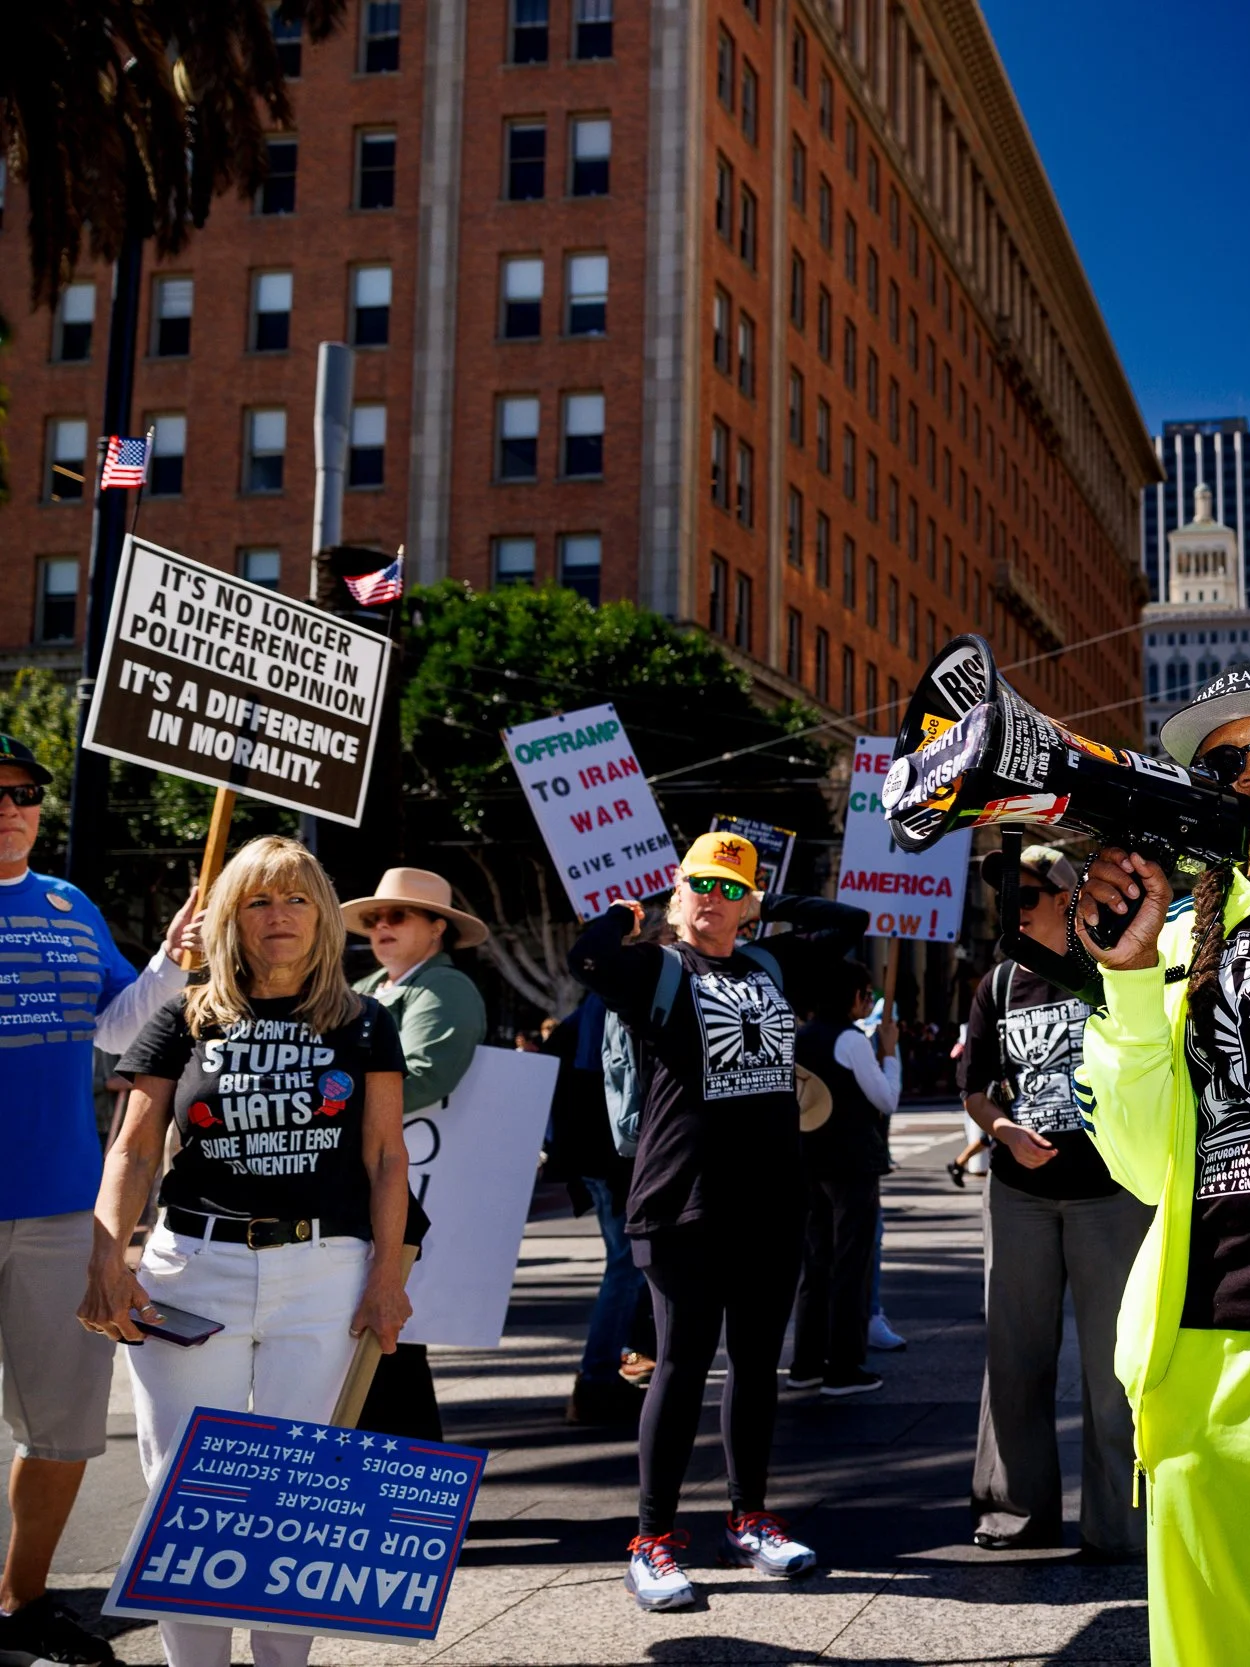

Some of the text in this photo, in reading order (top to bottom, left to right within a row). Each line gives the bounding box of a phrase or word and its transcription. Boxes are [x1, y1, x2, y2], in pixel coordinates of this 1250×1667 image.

[160, 563, 352, 657] IT'S NO LONGER
[148, 591, 358, 688] A DIFFERENCE IN
[129, 614, 366, 720] POLITICAL OPINION
[118, 659, 359, 764] IT'S A DIFFERENCE
[148, 709, 322, 789] IN MORALITY.
[514, 719, 620, 765] OFFRAMP
[531, 755, 640, 803] TO IRAN
[569, 798, 634, 834] WAR
[567, 833, 672, 880] GIVE THEM
[840, 870, 953, 897] AMERICA
[867, 909, 938, 938] OW!
[46, 950, 78, 964] fine
[19, 990, 57, 1006] your
[254, 1019, 298, 1041] CAN'T
[202, 1039, 335, 1073] STUPID
[218, 1073, 262, 1094] BUT
[270, 1071, 315, 1090] THE
[222, 1092, 313, 1132] HATS
[200, 1127, 342, 1159] SURE MAKE IT EASY
[247, 1153, 319, 1176] IDENTIFY
[201, 1436, 315, 1465] HEALTHCARE
[192, 1459, 350, 1490] SOCIAL SECURITY
[362, 1457, 468, 1486] OUR BODIES
[276, 1492, 366, 1516] MEDICARE
[379, 1483, 460, 1506] REFUGEES
[164, 1506, 447, 1561] OUR DEMOCRACY
[141, 1543, 439, 1612] HANDS OFF
